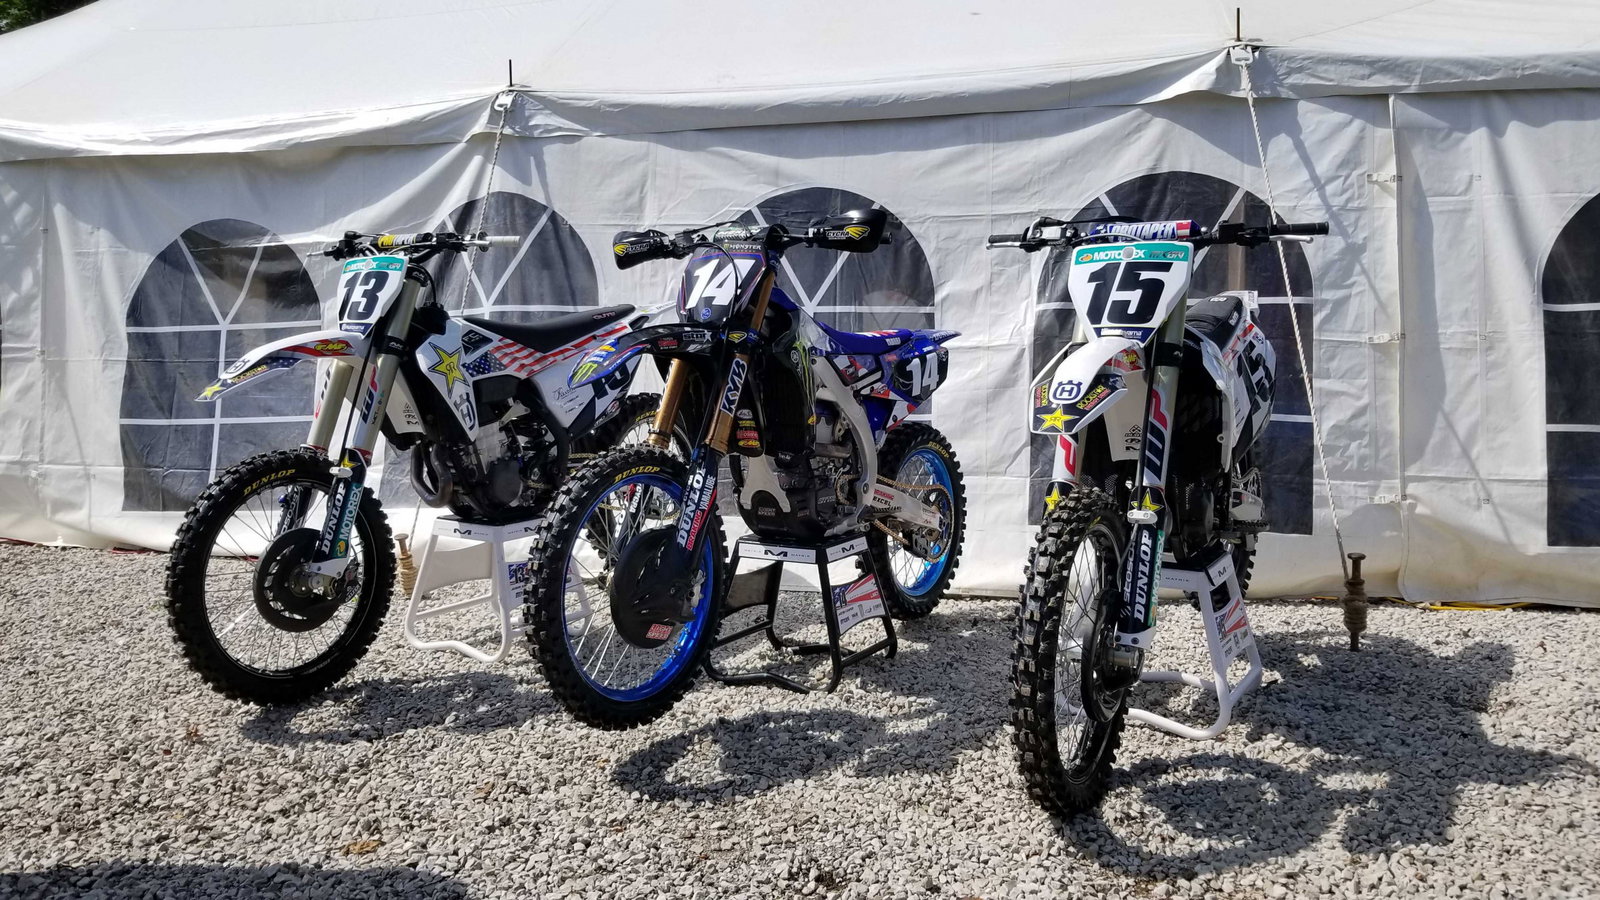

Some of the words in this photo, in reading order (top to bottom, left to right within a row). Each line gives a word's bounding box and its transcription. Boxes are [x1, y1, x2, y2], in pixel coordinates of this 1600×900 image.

[826, 230, 850, 238] CYCRA
[1093, 250, 1147, 260] MOTOEX
[338, 271, 389, 321] 13
[686, 258, 755, 309] 14
[1086, 261, 1174, 325] 15
[719, 357, 748, 418] KYB
[905, 351, 940, 397] 14
[243, 468, 297, 496] DUNLOP
[613, 465, 661, 483] DUNLOP
[700, 475, 716, 511] YAMALUBE
[321, 481, 347, 555] DUNLOP
[338, 485, 363, 540] MOTOREX
[686, 509, 702, 551] BRAKING
[1134, 529, 1153, 623] DUNLOP
[1151, 533, 1165, 604] MOTOREX
